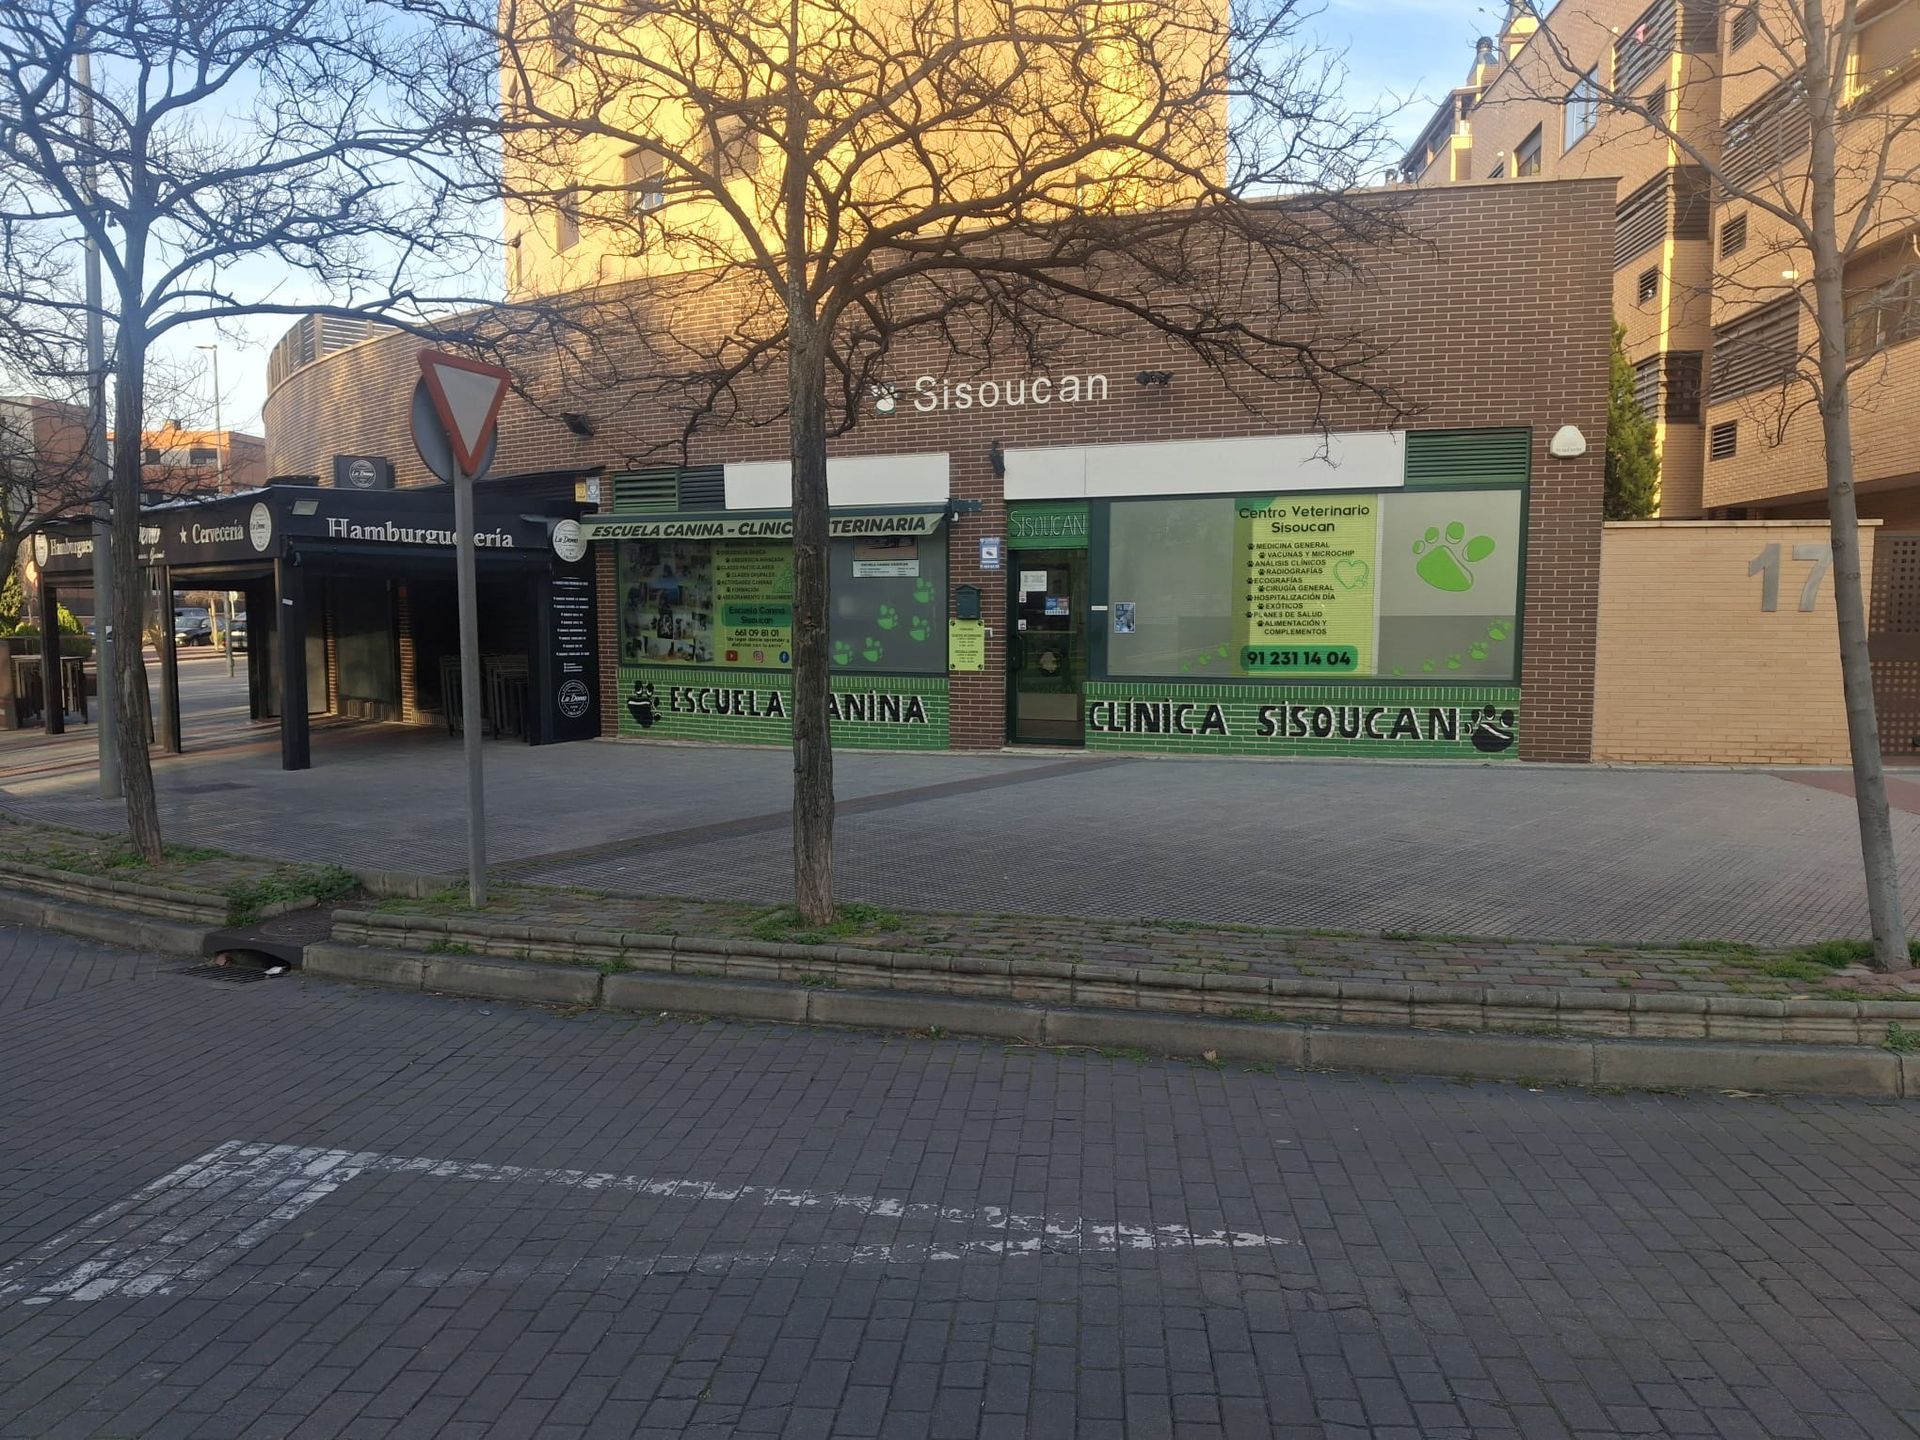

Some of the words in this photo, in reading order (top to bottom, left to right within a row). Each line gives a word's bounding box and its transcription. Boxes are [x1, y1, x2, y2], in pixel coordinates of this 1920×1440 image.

[913, 372, 1108, 412] Sisoucan
[1239, 506, 1287, 518] Centro
[1292, 504, 1370, 517] Veterinario
[192, 519, 244, 544] Cervecería
[592, 523, 661, 537] ESCUELA
[663, 522, 723, 536] CANINA
[738, 520, 793, 536] CLINIC
[830, 516, 926, 534] TERINARIA
[1271, 522, 1335, 533] Sisoucan
[326, 517, 514, 548] Hamburguería
[1291, 558, 1326, 566] CLÍNICOS
[1254, 576, 1302, 584] ECOGRAFÍAS
[1747, 543, 1833, 612] 17
[1265, 584, 1296, 592] CIRUGÍA
[1254, 593, 1320, 601] HOSPITALIZACIÓN
[1322, 592, 1336, 600] DÍA
[729, 606, 758, 614] Escuela
[759, 606, 785, 614] Canina
[740, 616, 773, 624] Sisoucan
[1264, 618, 1320, 626] ALIMENTACIÓN
[734, 629, 747, 637] 661
[748, 629, 759, 637] 09
[770, 629, 780, 637] 01
[1247, 652, 1265, 665] 91
[1270, 652, 1298, 665] 231
[1304, 652, 1322, 665] 14
[1326, 652, 1351, 665] 04
[670, 687, 787, 719] ESCUELA
[827, 690, 928, 724] ANINA
